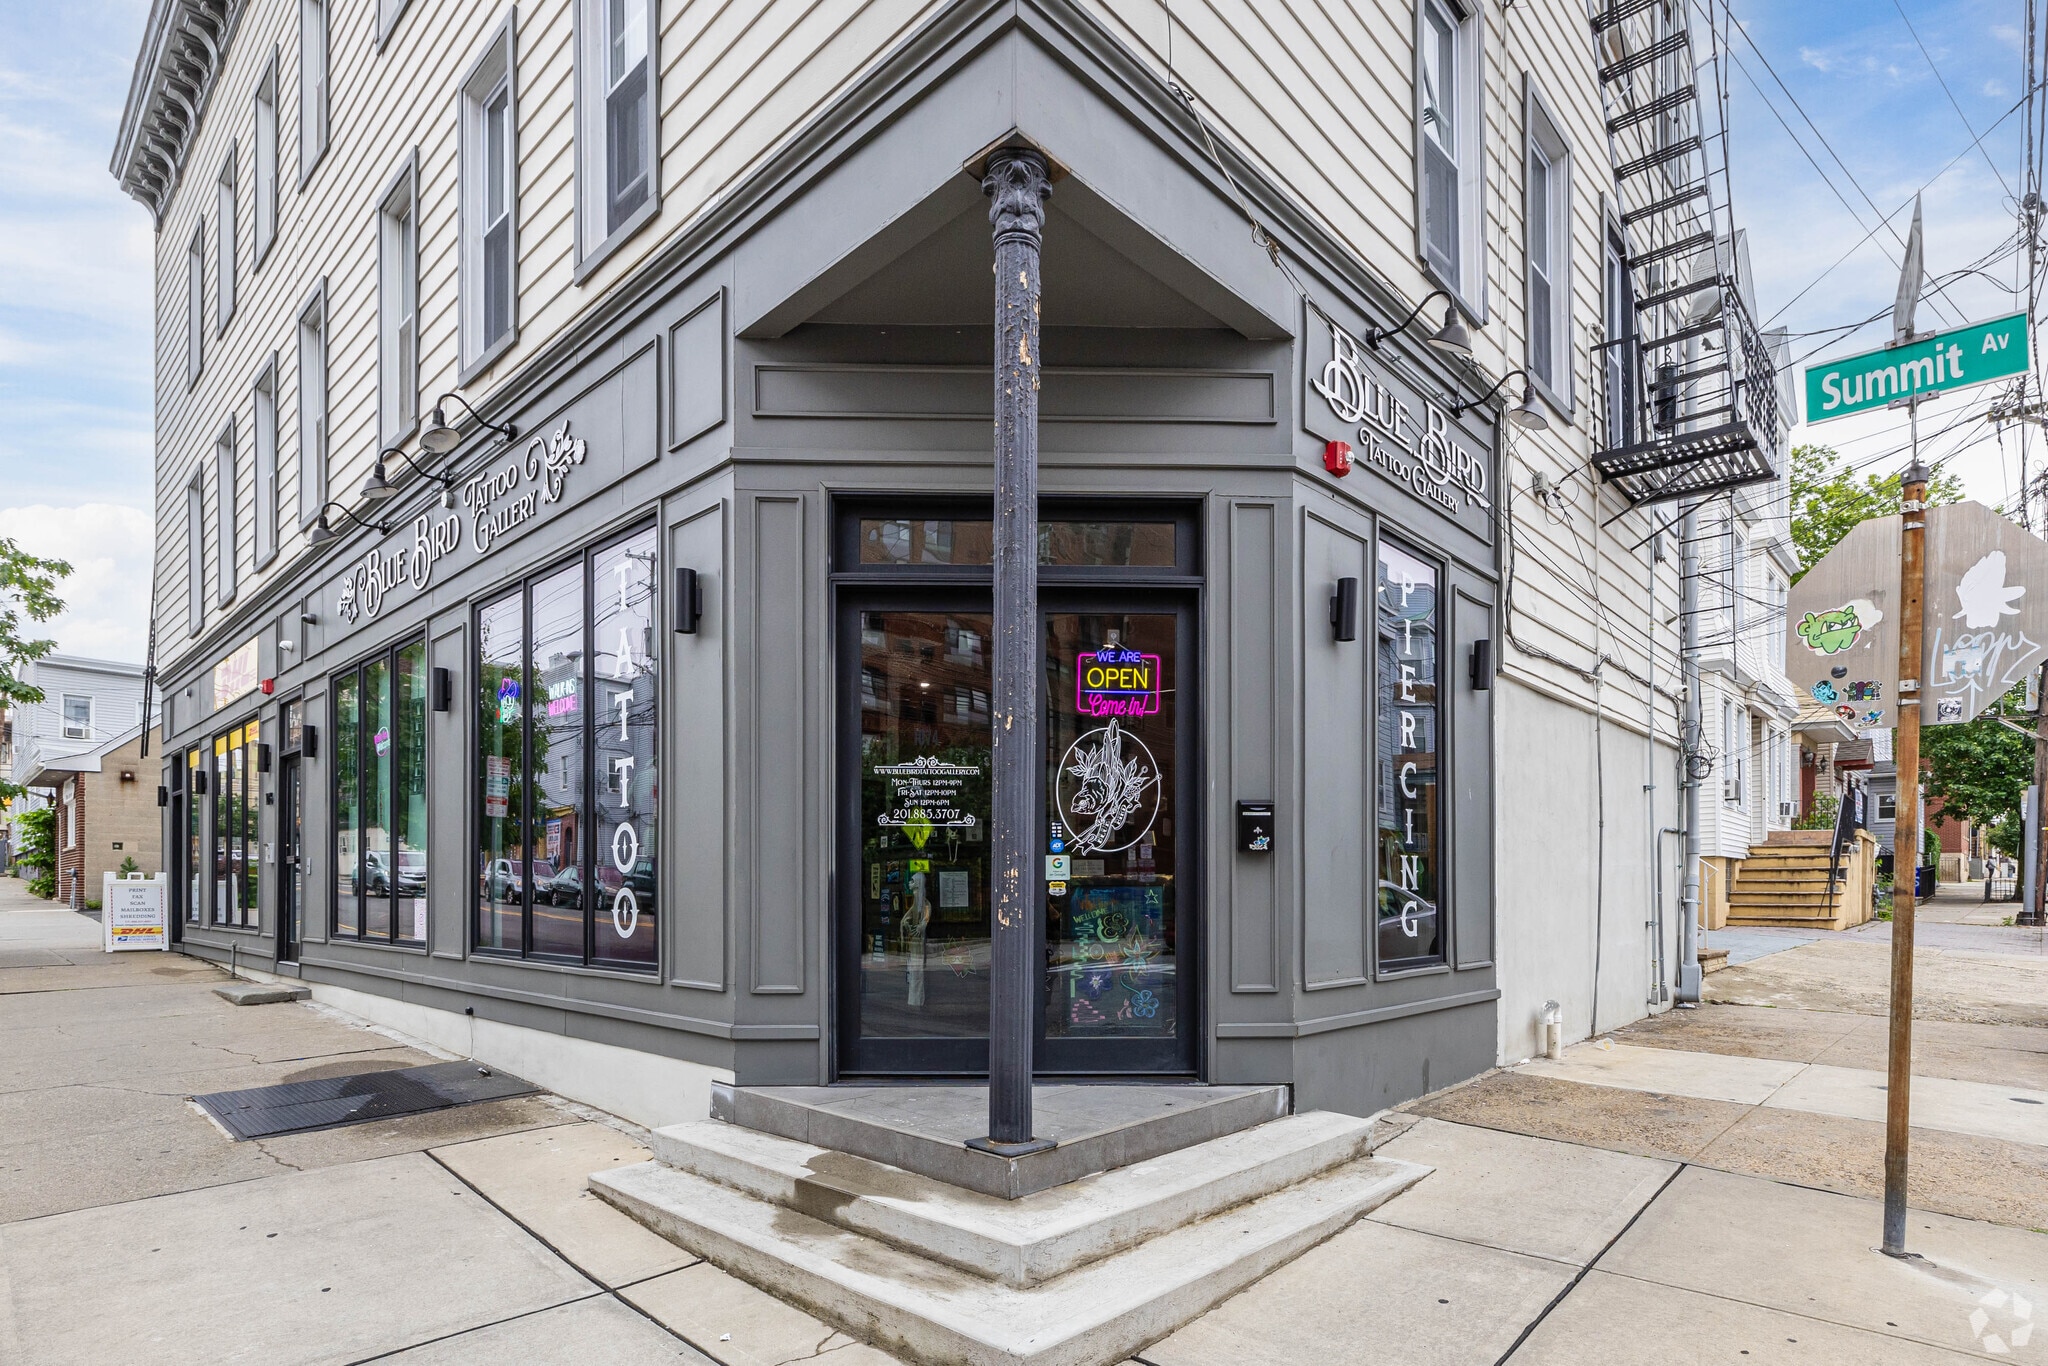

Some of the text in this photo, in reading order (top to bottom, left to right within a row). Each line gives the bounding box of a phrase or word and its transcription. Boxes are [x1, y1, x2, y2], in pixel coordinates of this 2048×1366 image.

[1821, 332, 2010, 411] Summit Av
[1311, 325, 1488, 502] BLUE BIRD
[463, 464, 518, 518] TATTOO
[1359, 427, 1460, 514] TATTOO GALLERY
[473, 489, 537, 554] GALLERY
[363, 514, 461, 618] BLUE BIRD
[1086, 667, 1148, 689] OPEN
[1096, 651, 1141, 663] WE ARE
[1088, 693, 1149, 717] Come in!
[611, 556, 640, 939] TATTOO
[1398, 571, 1419, 938] PIERCING
[893, 808, 961, 819] 201.885.3707
